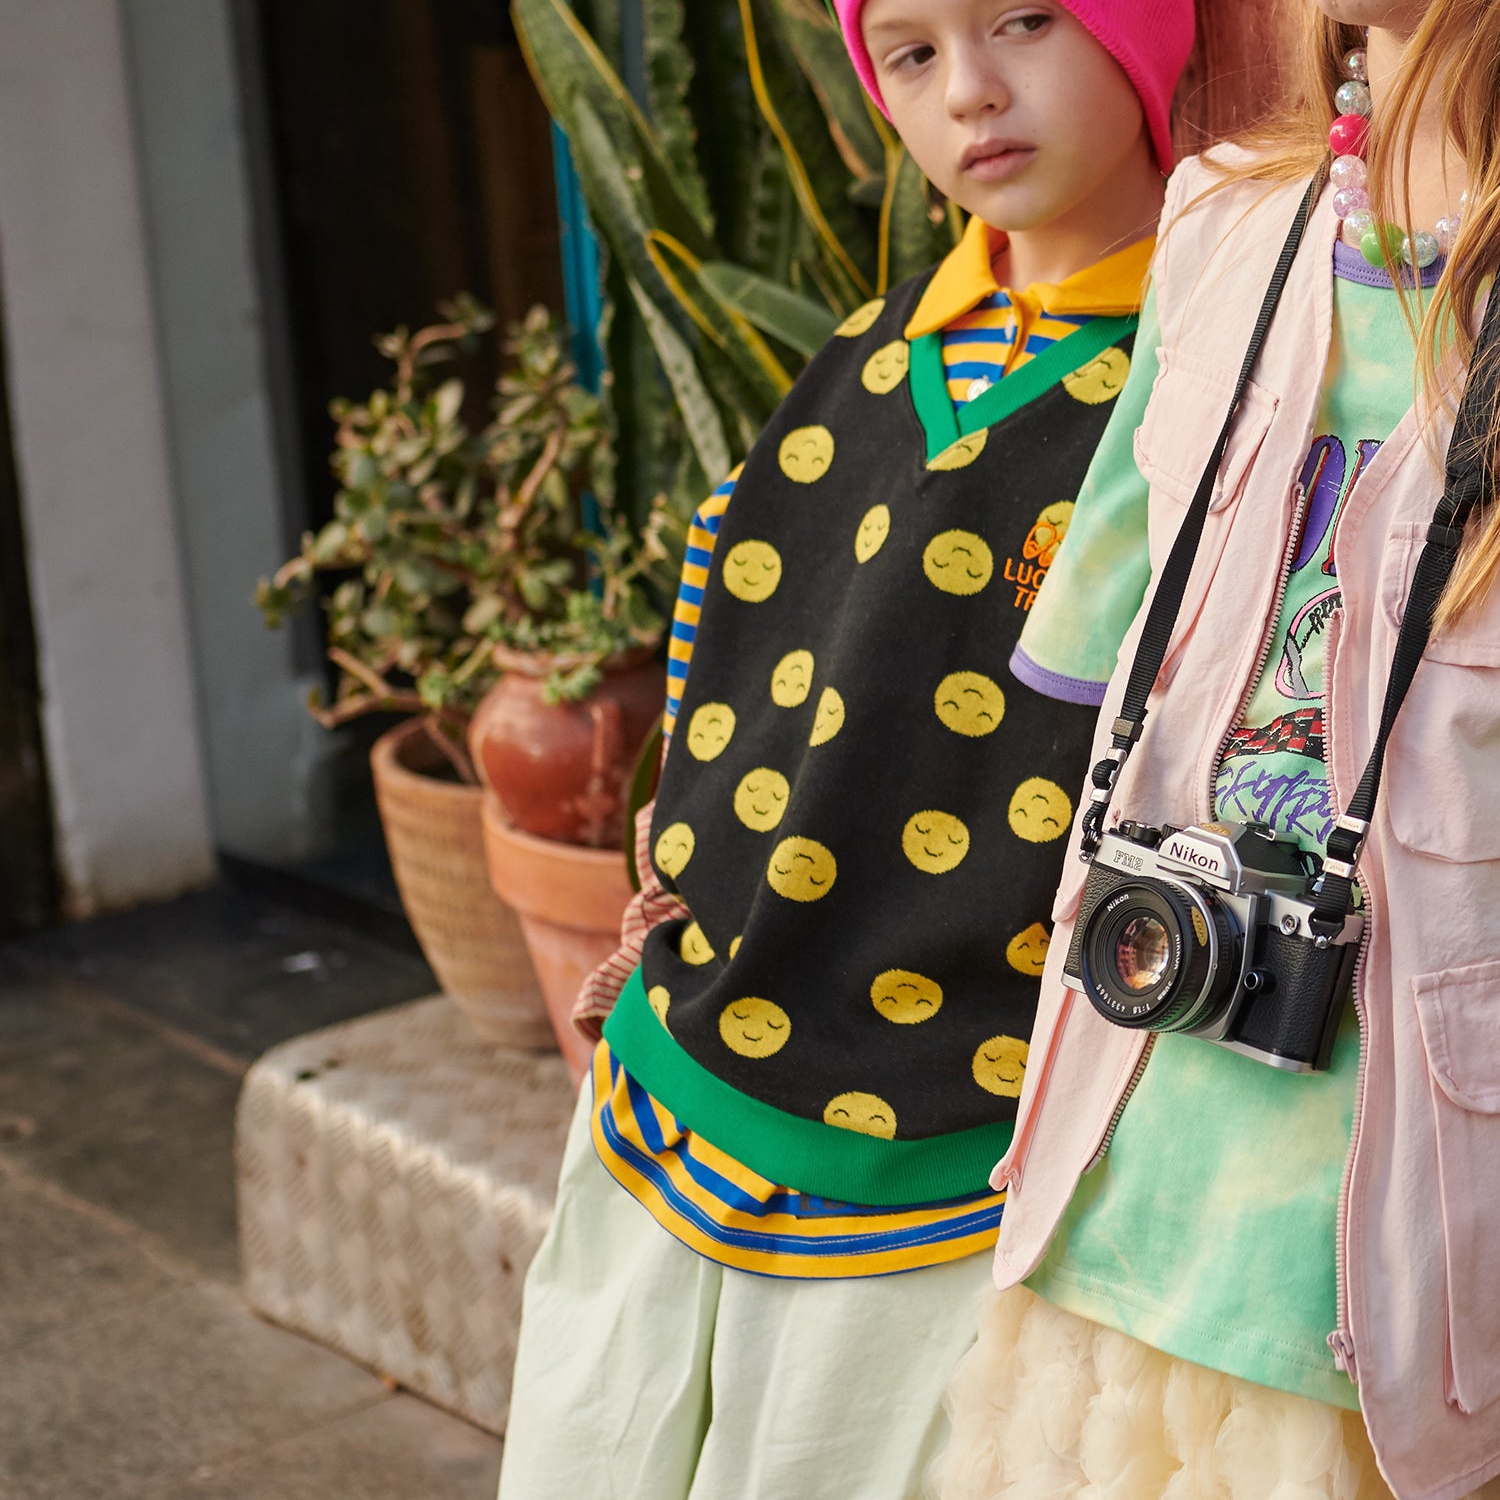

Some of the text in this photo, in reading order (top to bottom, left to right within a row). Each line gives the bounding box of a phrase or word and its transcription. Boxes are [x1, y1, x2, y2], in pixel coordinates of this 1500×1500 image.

[1003, 557, 1048, 590] LUC
[1113, 849, 1144, 872] FM2
[1169, 842, 1219, 872] Nikon
[1106, 893, 1130, 912] Nikon
